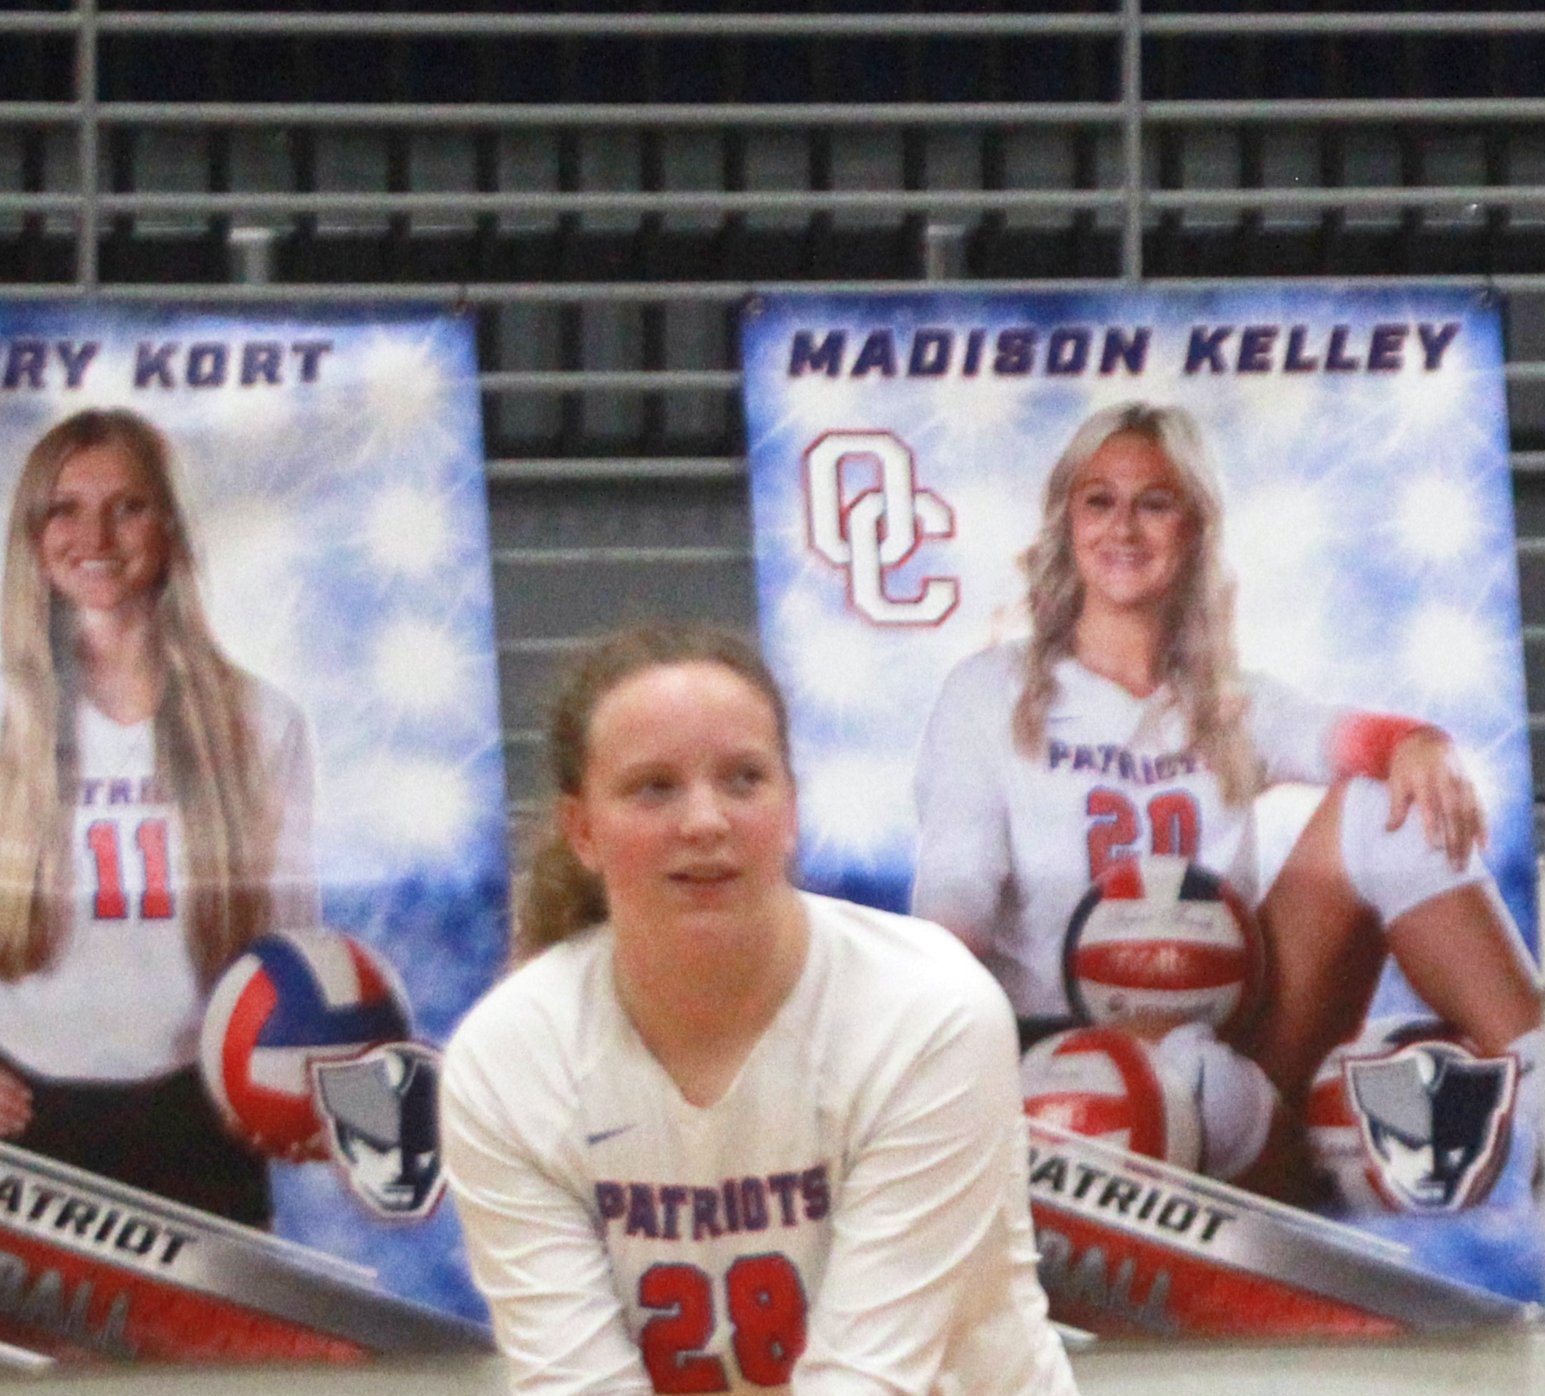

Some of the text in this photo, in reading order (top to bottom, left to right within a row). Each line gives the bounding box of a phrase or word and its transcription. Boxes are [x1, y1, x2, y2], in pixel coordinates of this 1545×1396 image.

[133, 339, 334, 390] KORT
[787, 321, 1463, 379] MADISON KELLEY
[803, 428, 961, 629] OC
[86, 818, 176, 920] 11
[1086, 785, 1201, 884] 20
[593, 1163, 832, 1240] PATRIOTS
[1029, 1147, 1237, 1243] ATRIOT
[638, 1250, 808, 1395] 28
